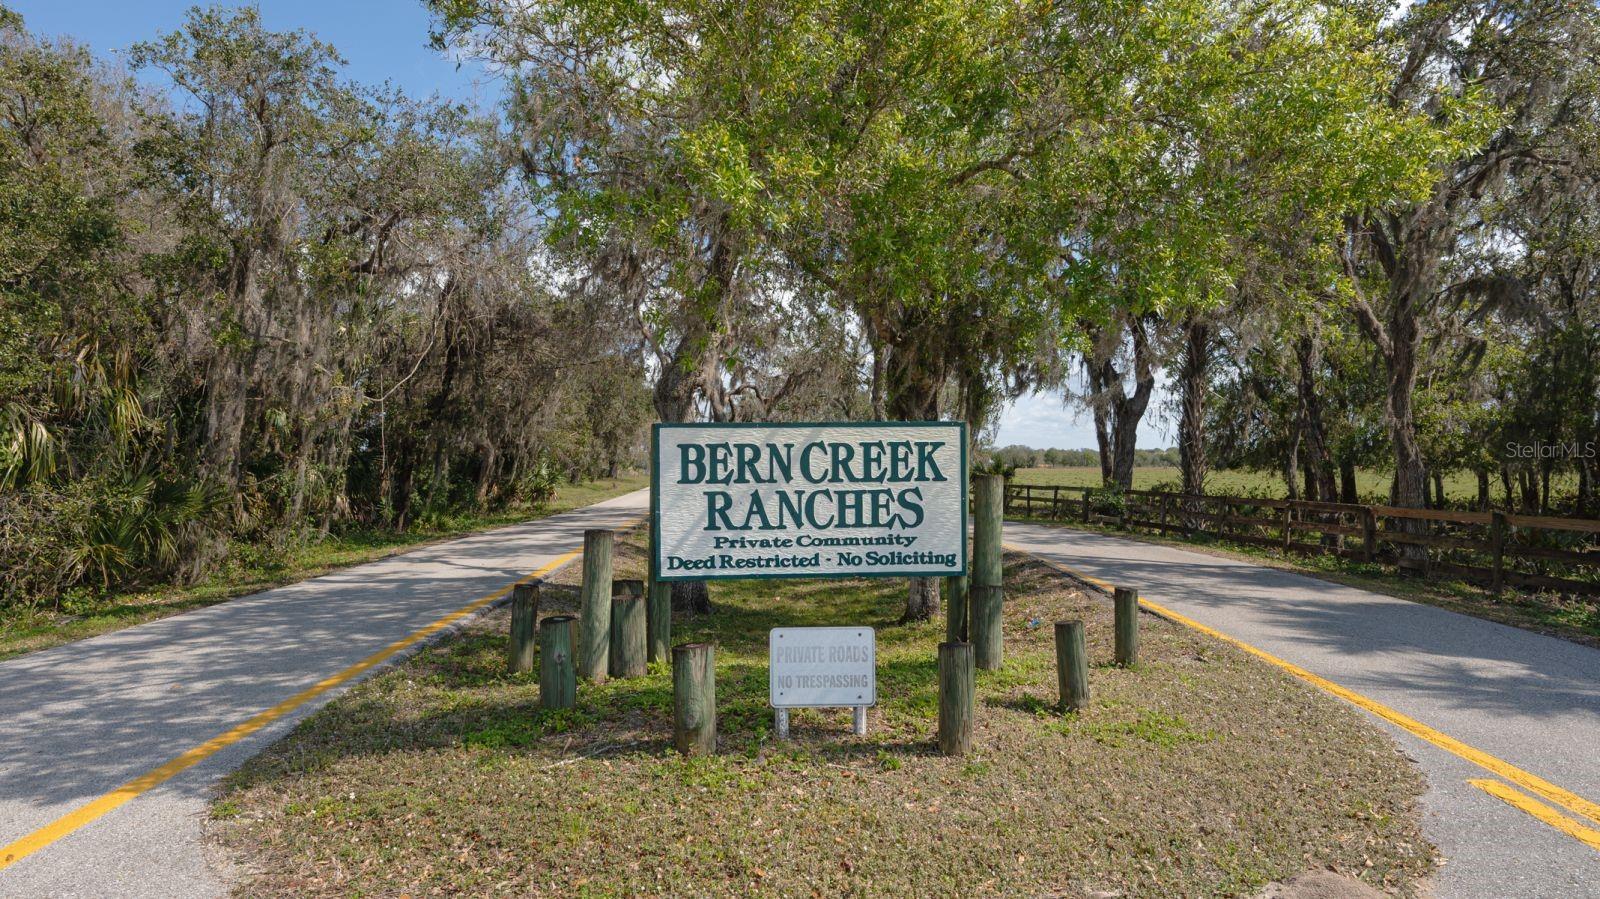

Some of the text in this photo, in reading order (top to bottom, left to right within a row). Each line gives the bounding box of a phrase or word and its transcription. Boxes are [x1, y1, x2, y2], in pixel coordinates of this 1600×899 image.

[676, 440, 948, 486] BERN CREEK
[703, 486, 924, 531] RANCHES
[713, 533, 918, 549] Private Community
[667, 556, 716, 571] Deed
[719, 552, 820, 569] Restricted
[836, 552, 863, 567] No
[865, 550, 957, 567] Soliciting
[776, 645, 869, 663] PRIVATE ROADS
[777, 674, 868, 689] NO TRESPASSING
